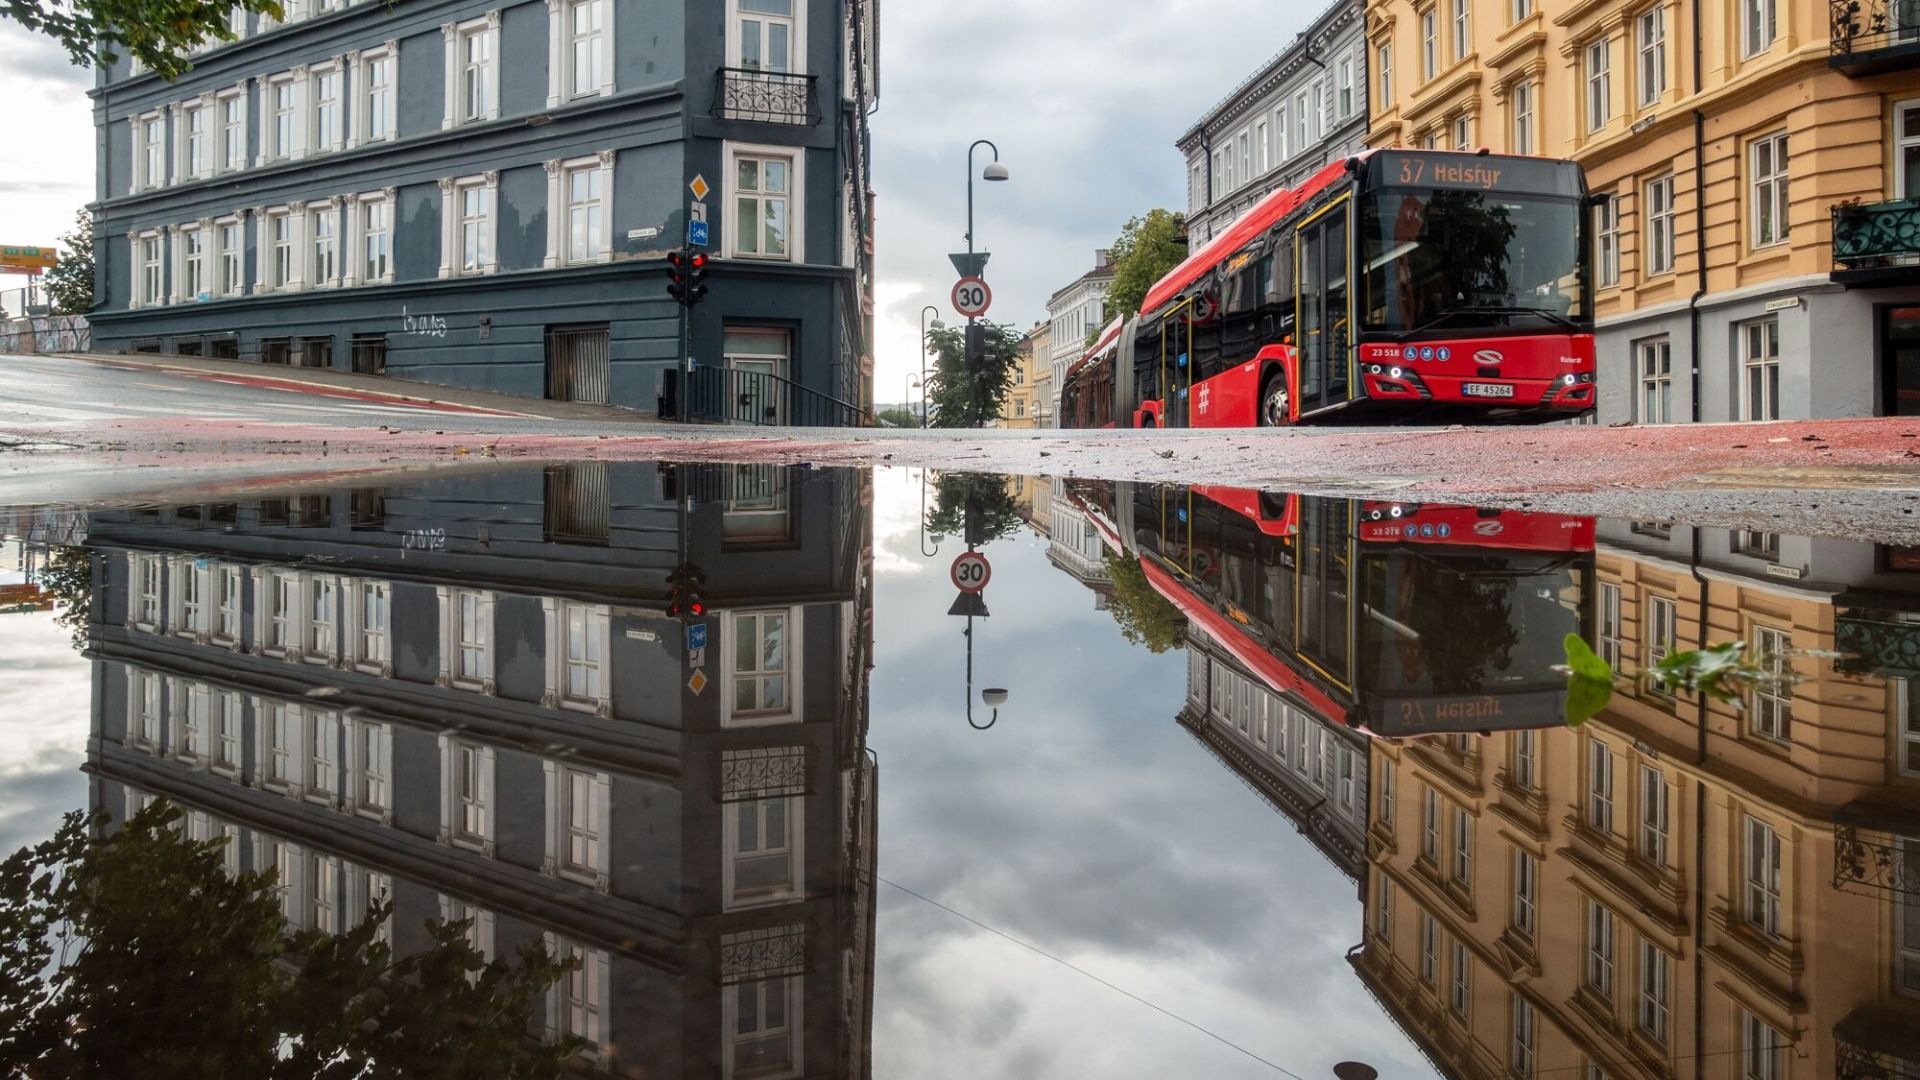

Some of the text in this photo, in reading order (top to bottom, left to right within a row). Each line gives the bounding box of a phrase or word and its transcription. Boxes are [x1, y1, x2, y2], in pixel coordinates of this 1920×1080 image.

[1400, 158, 1502, 190] 37 Helsfyr
[959, 287, 984, 307] 30
[1372, 348, 1400, 357] 23 518
[1470, 384, 1511, 395] EF 45264
